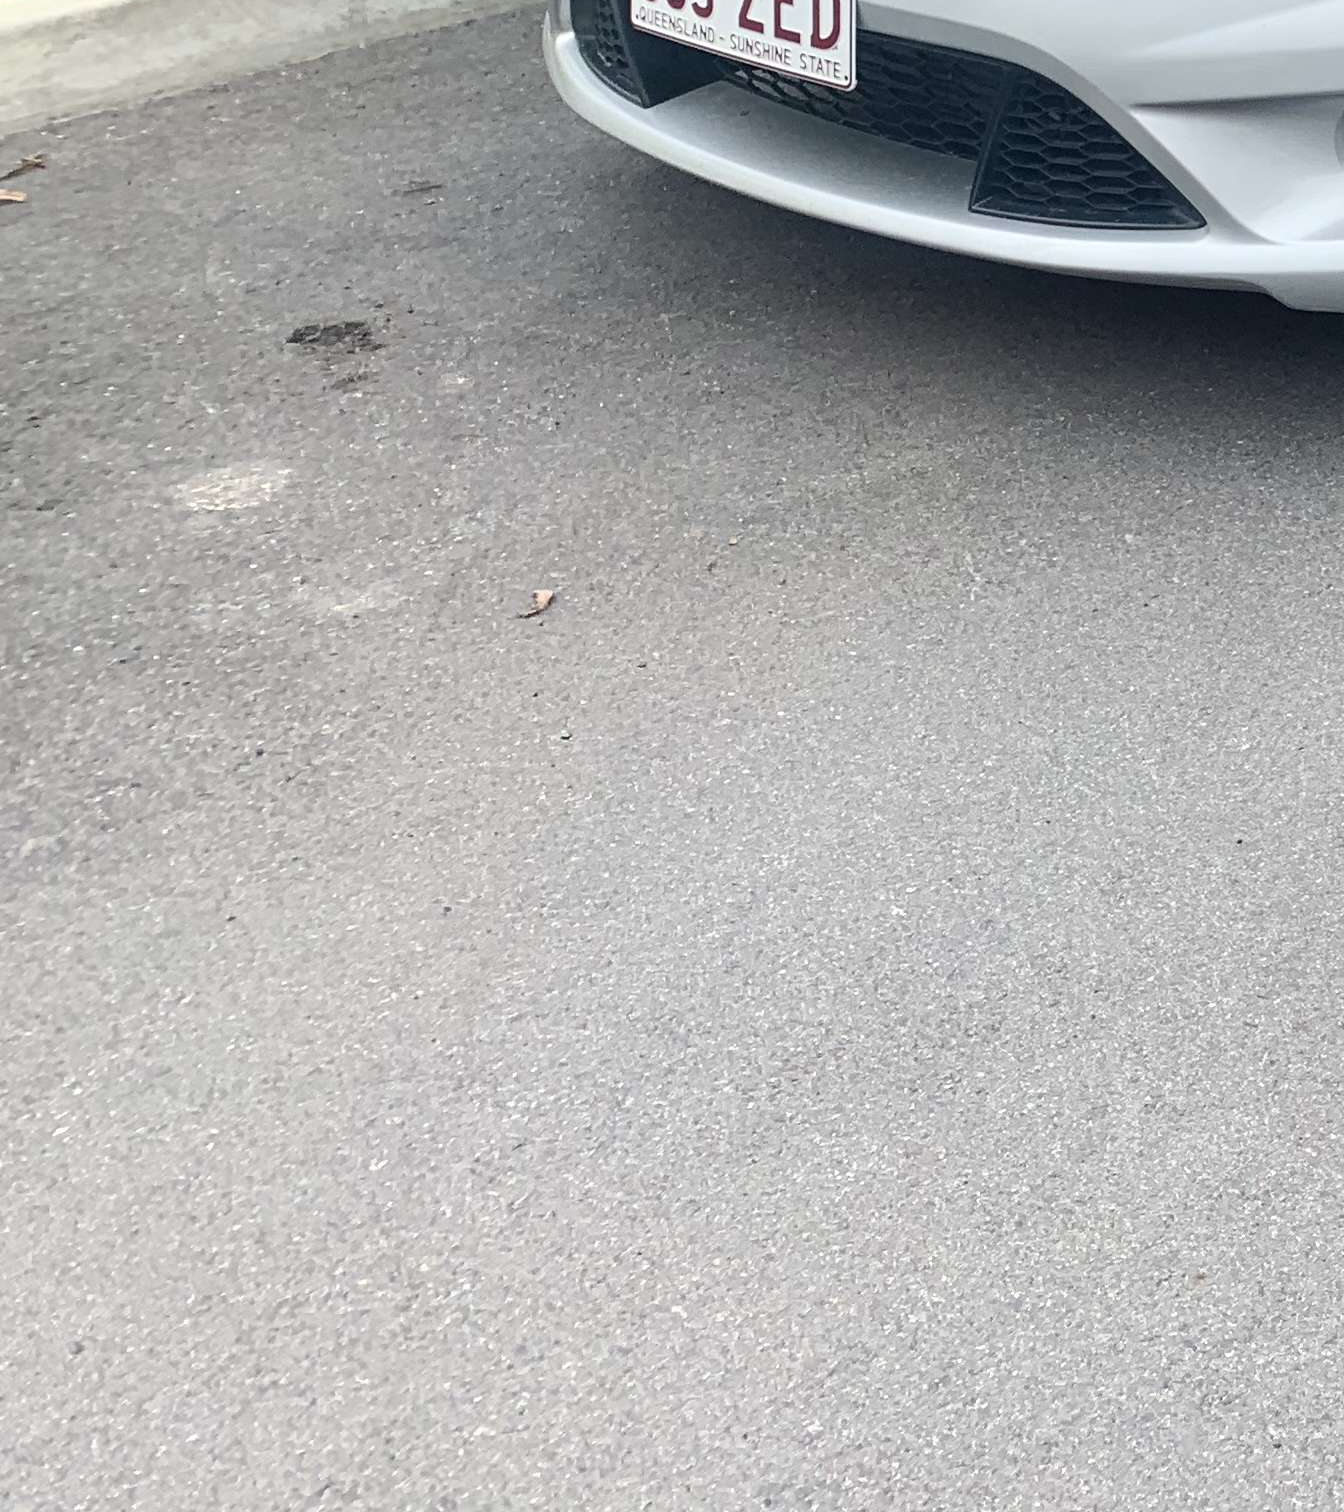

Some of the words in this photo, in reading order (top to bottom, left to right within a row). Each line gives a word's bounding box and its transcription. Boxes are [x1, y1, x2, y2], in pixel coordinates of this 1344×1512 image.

[639, 5, 715, 43] QUEENSLAND
[730, 33, 791, 66] SUNSHINE
[799, 52, 842, 80] STATE
